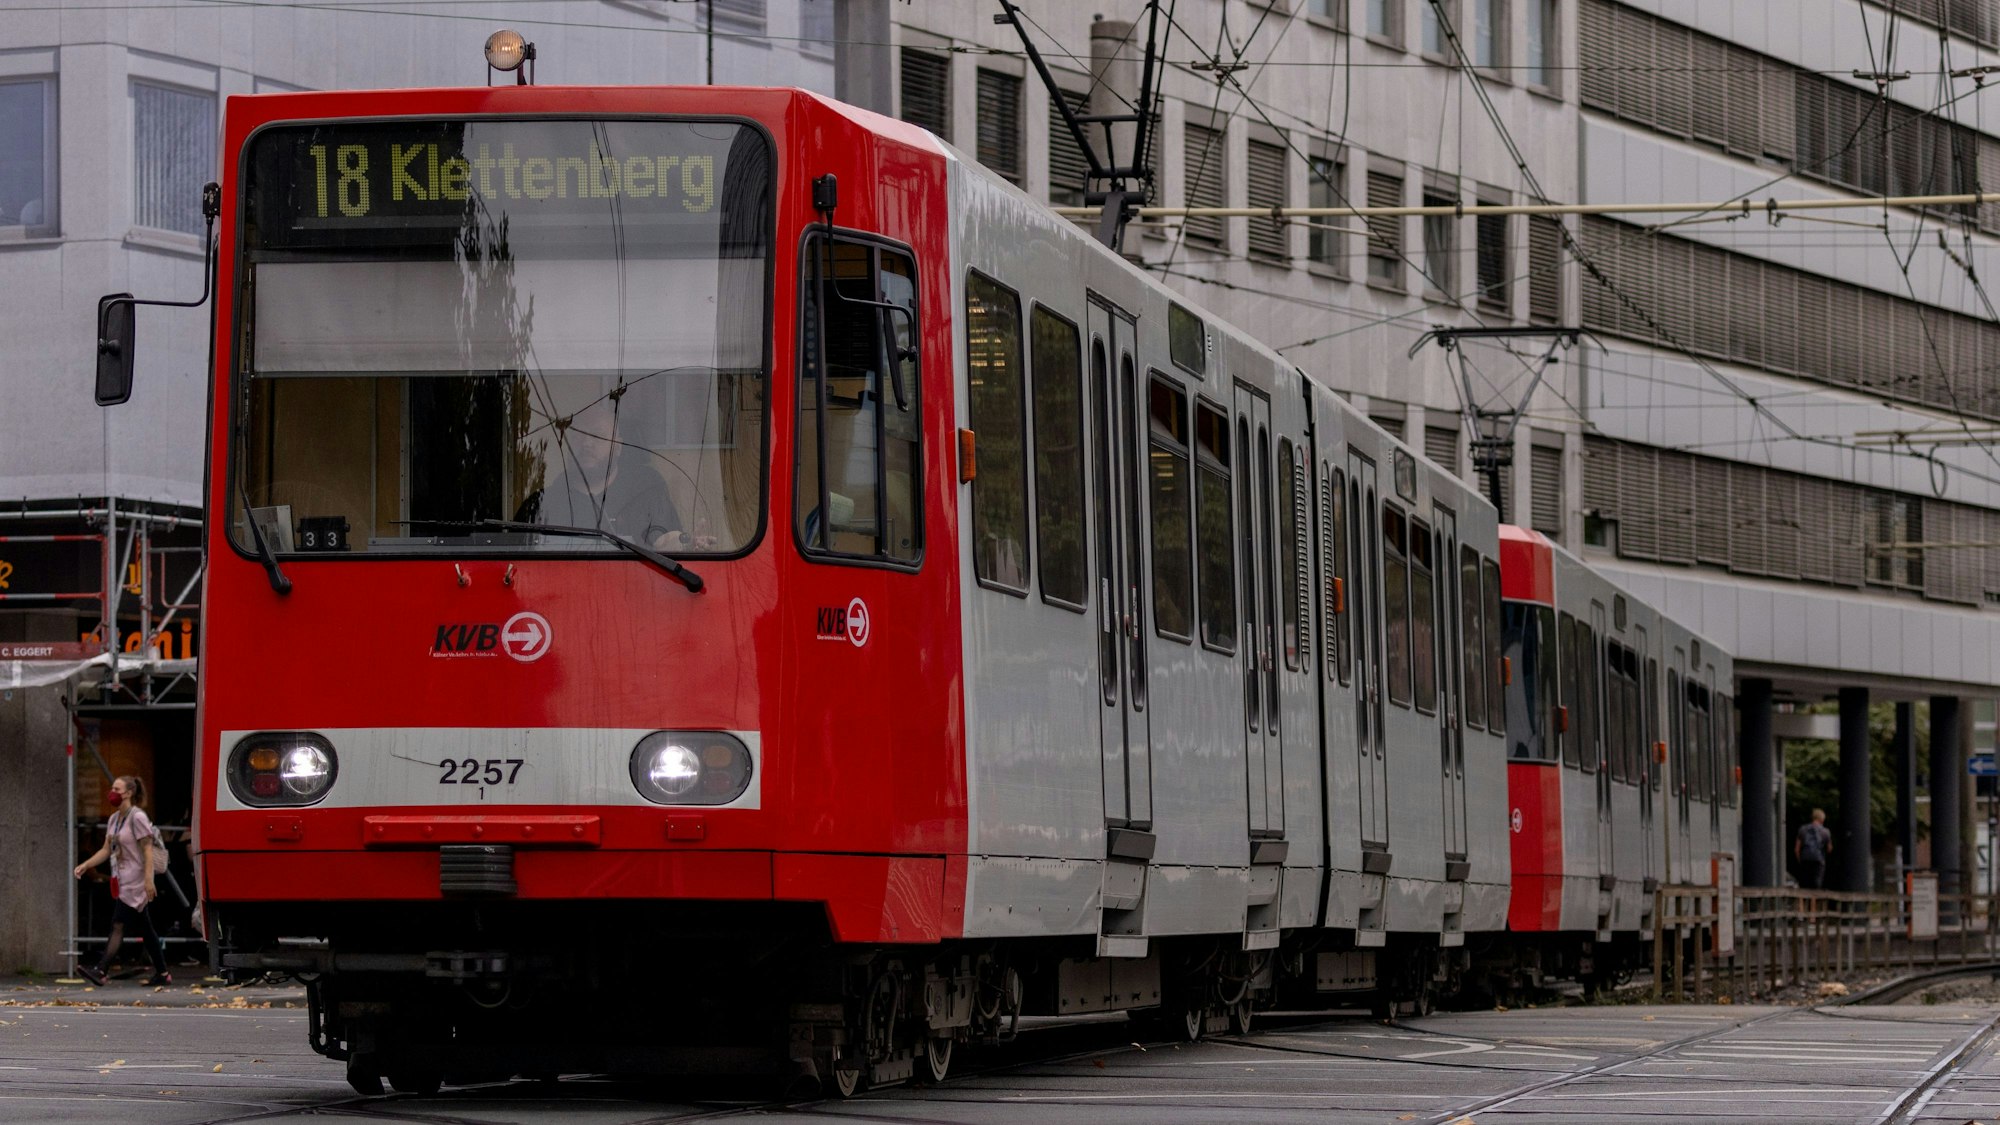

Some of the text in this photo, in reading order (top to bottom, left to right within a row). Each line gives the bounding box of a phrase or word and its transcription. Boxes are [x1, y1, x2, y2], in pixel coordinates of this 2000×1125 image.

[310, 143, 714, 218] 18 Klettenberg
[817, 607, 846, 635] KVB
[434, 623, 500, 652] KVB
[1, 646, 54, 657] C. EGGERT
[439, 758, 524, 785] 2257
[479, 786, 485, 800] 1
